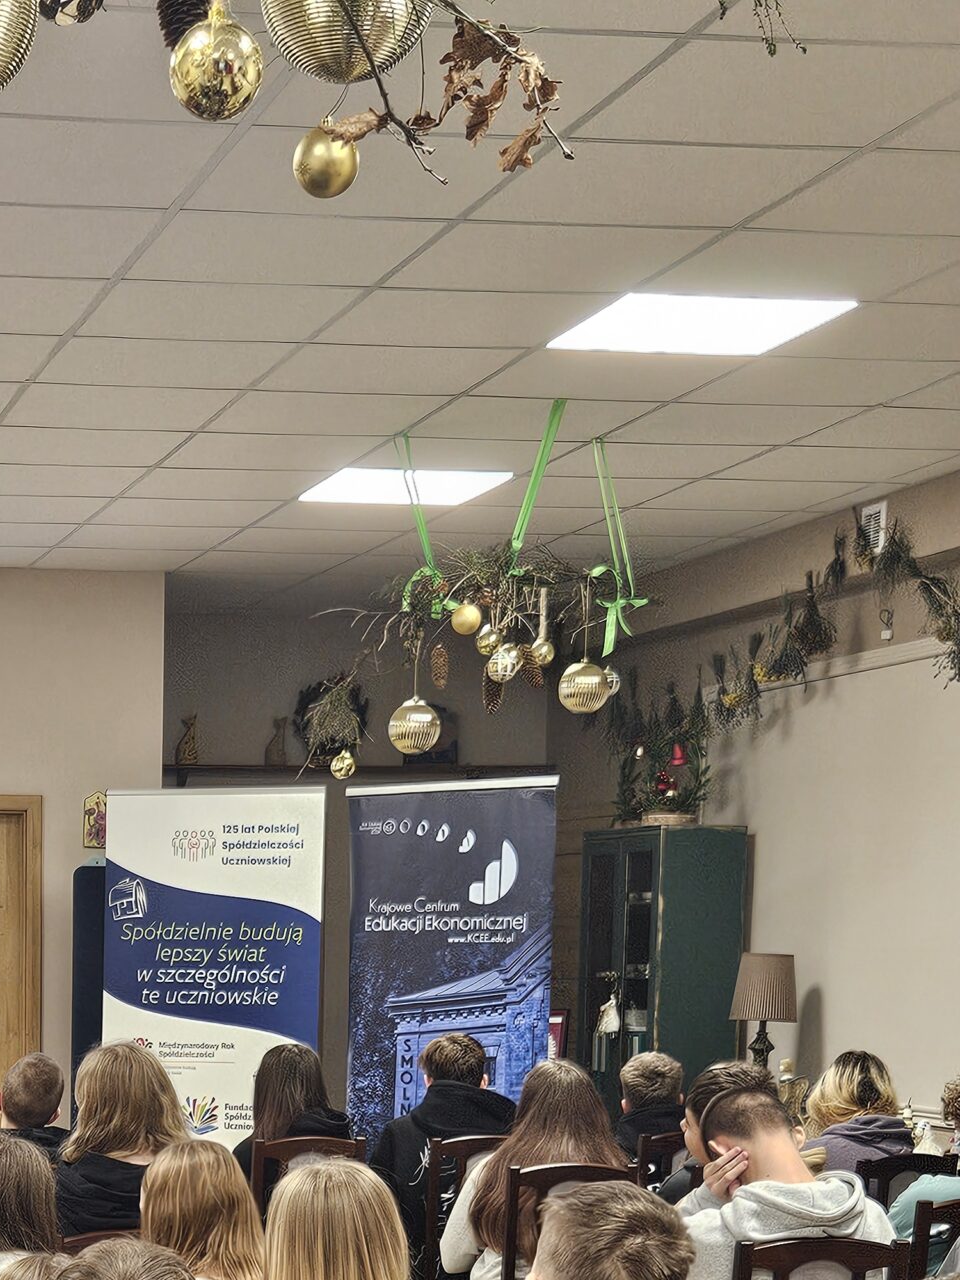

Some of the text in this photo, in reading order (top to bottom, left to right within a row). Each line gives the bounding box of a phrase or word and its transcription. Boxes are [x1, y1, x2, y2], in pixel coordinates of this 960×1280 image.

[222, 824, 299, 836] 125 lat Polskiej
[222, 840, 304, 852] Spółdzielczości
[222, 856, 291, 867] Uczniowskiej
[369, 897, 459, 915] Krajowe Centrum
[364, 912, 528, 935] Edukacji Ekonomicznej
[121, 921, 304, 945] Spółdzielnie budują
[448, 934, 514, 944] www.KCEE.edu.pl
[155, 943, 267, 967] lepszy świat
[137, 964, 287, 990] w szczególności
[141, 986, 279, 1005] te uczniowskie
[159, 1042, 219, 1051] Międzynarodowy
